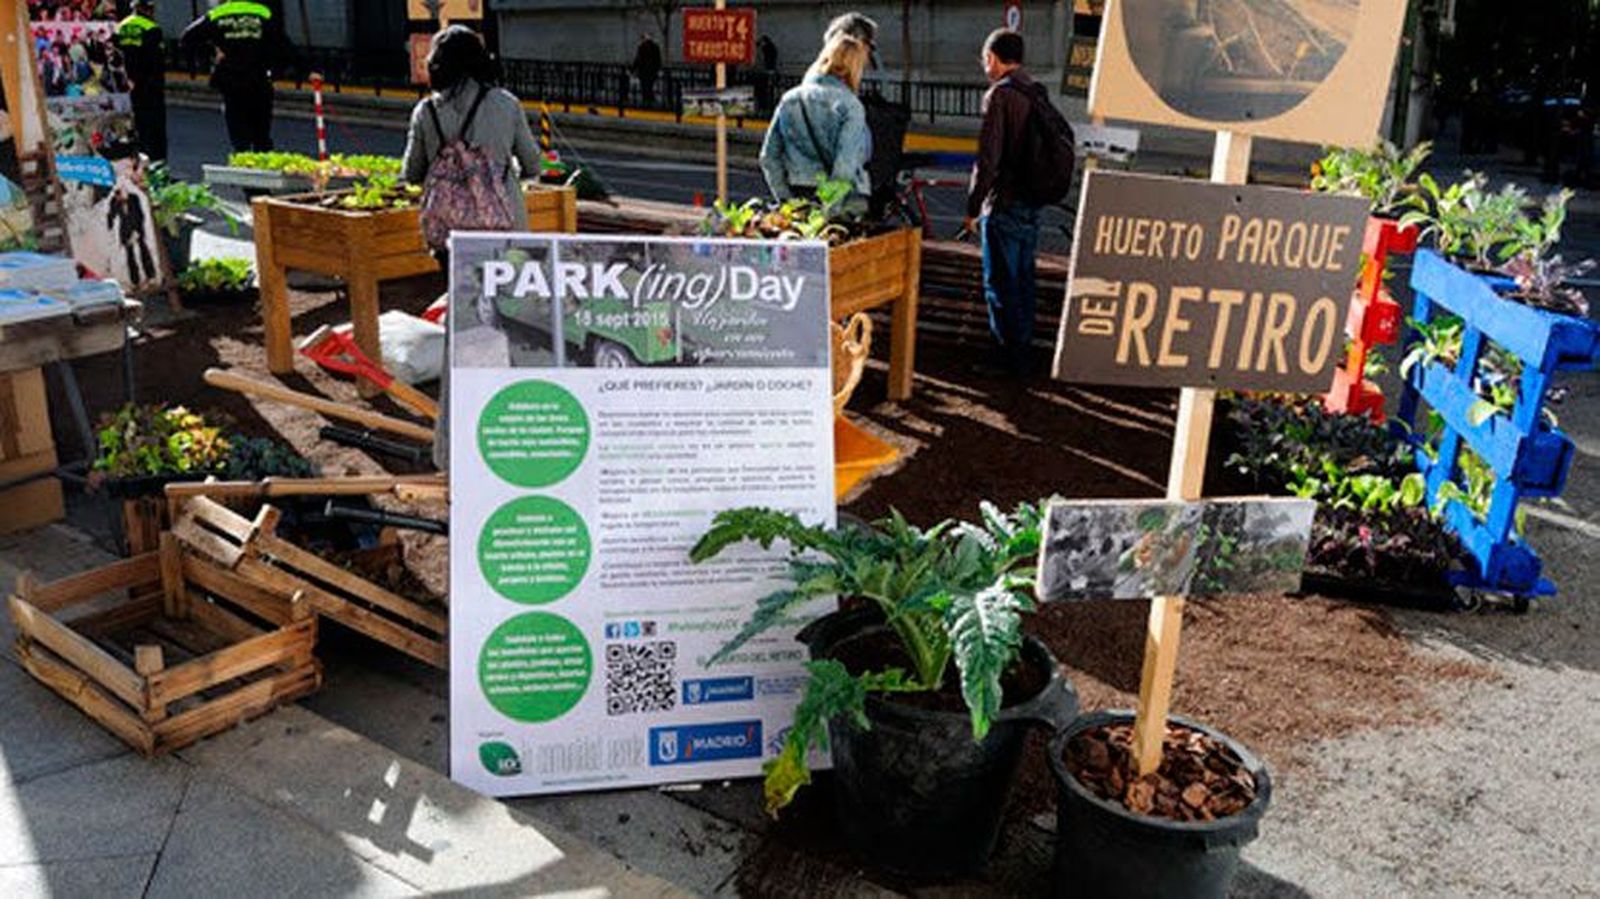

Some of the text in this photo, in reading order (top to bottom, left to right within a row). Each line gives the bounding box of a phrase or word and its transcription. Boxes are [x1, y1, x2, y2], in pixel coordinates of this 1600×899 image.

[1094, 214, 1350, 271] HUERTO PARQUE
[483, 260, 806, 311] PARK(ing)Day
[1116, 282, 1338, 375] RETIRO
[633, 380, 703, 391] PREFIERES?
[767, 380, 812, 391] COCHE?
